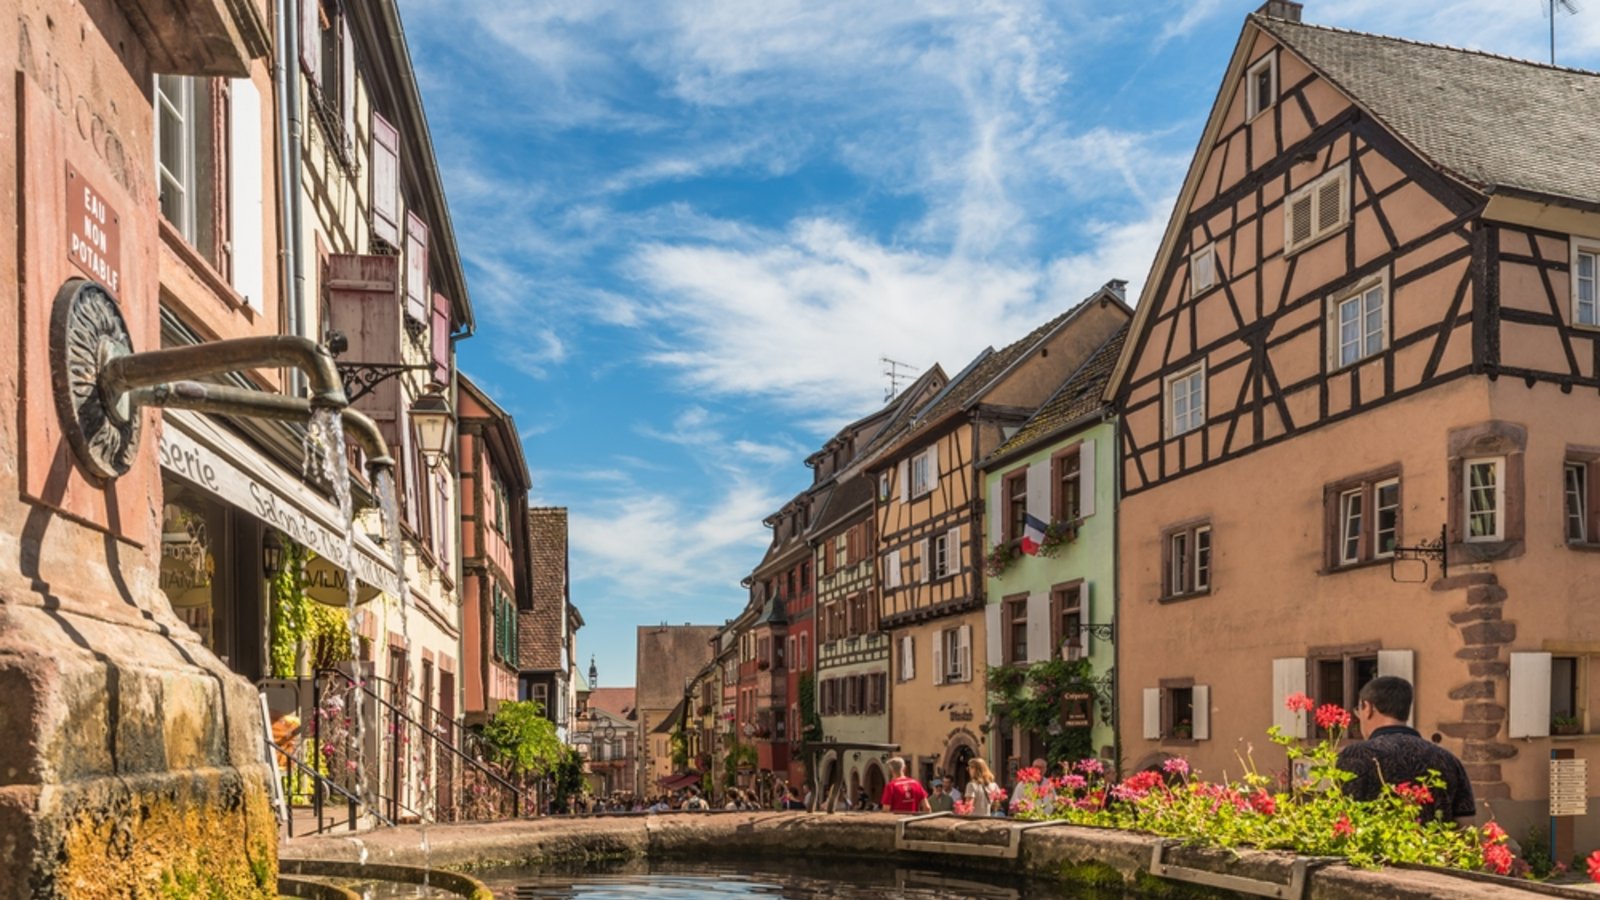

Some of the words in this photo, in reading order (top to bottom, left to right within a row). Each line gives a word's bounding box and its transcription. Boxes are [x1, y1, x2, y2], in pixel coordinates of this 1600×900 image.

[84, 186, 105, 225] EAU
[84, 215, 106, 254] NON
[72, 233, 118, 292] POTABLE
[249, 481, 300, 540] Salon
[299, 513, 318, 546] de
